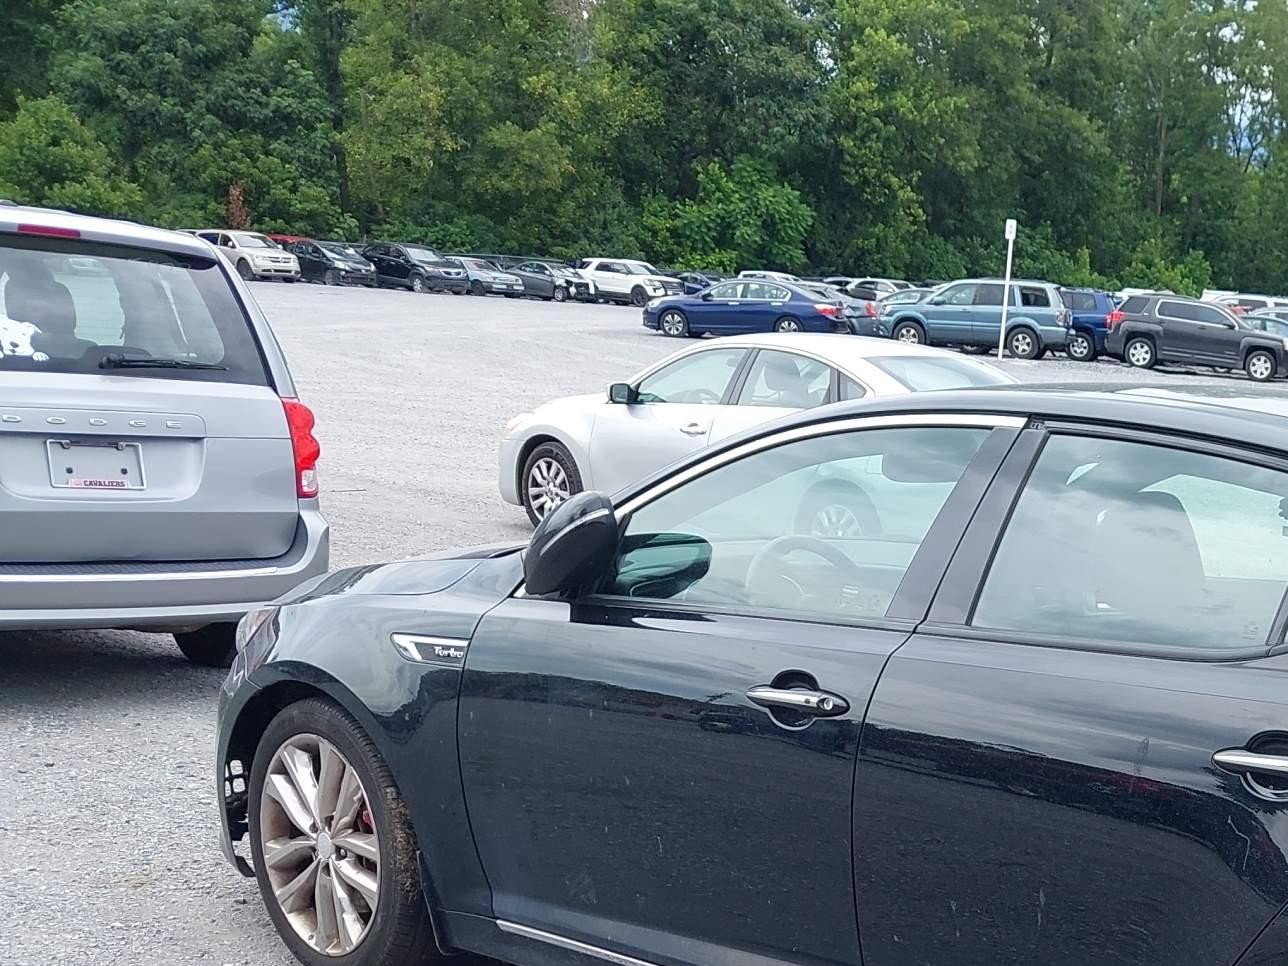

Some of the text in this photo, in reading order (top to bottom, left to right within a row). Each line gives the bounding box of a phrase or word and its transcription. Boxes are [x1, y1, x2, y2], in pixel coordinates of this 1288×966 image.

[1, 414, 184, 429] DODGE
[83, 479, 126, 488] CAVALIERS
[434, 646, 464, 657] Turbo
